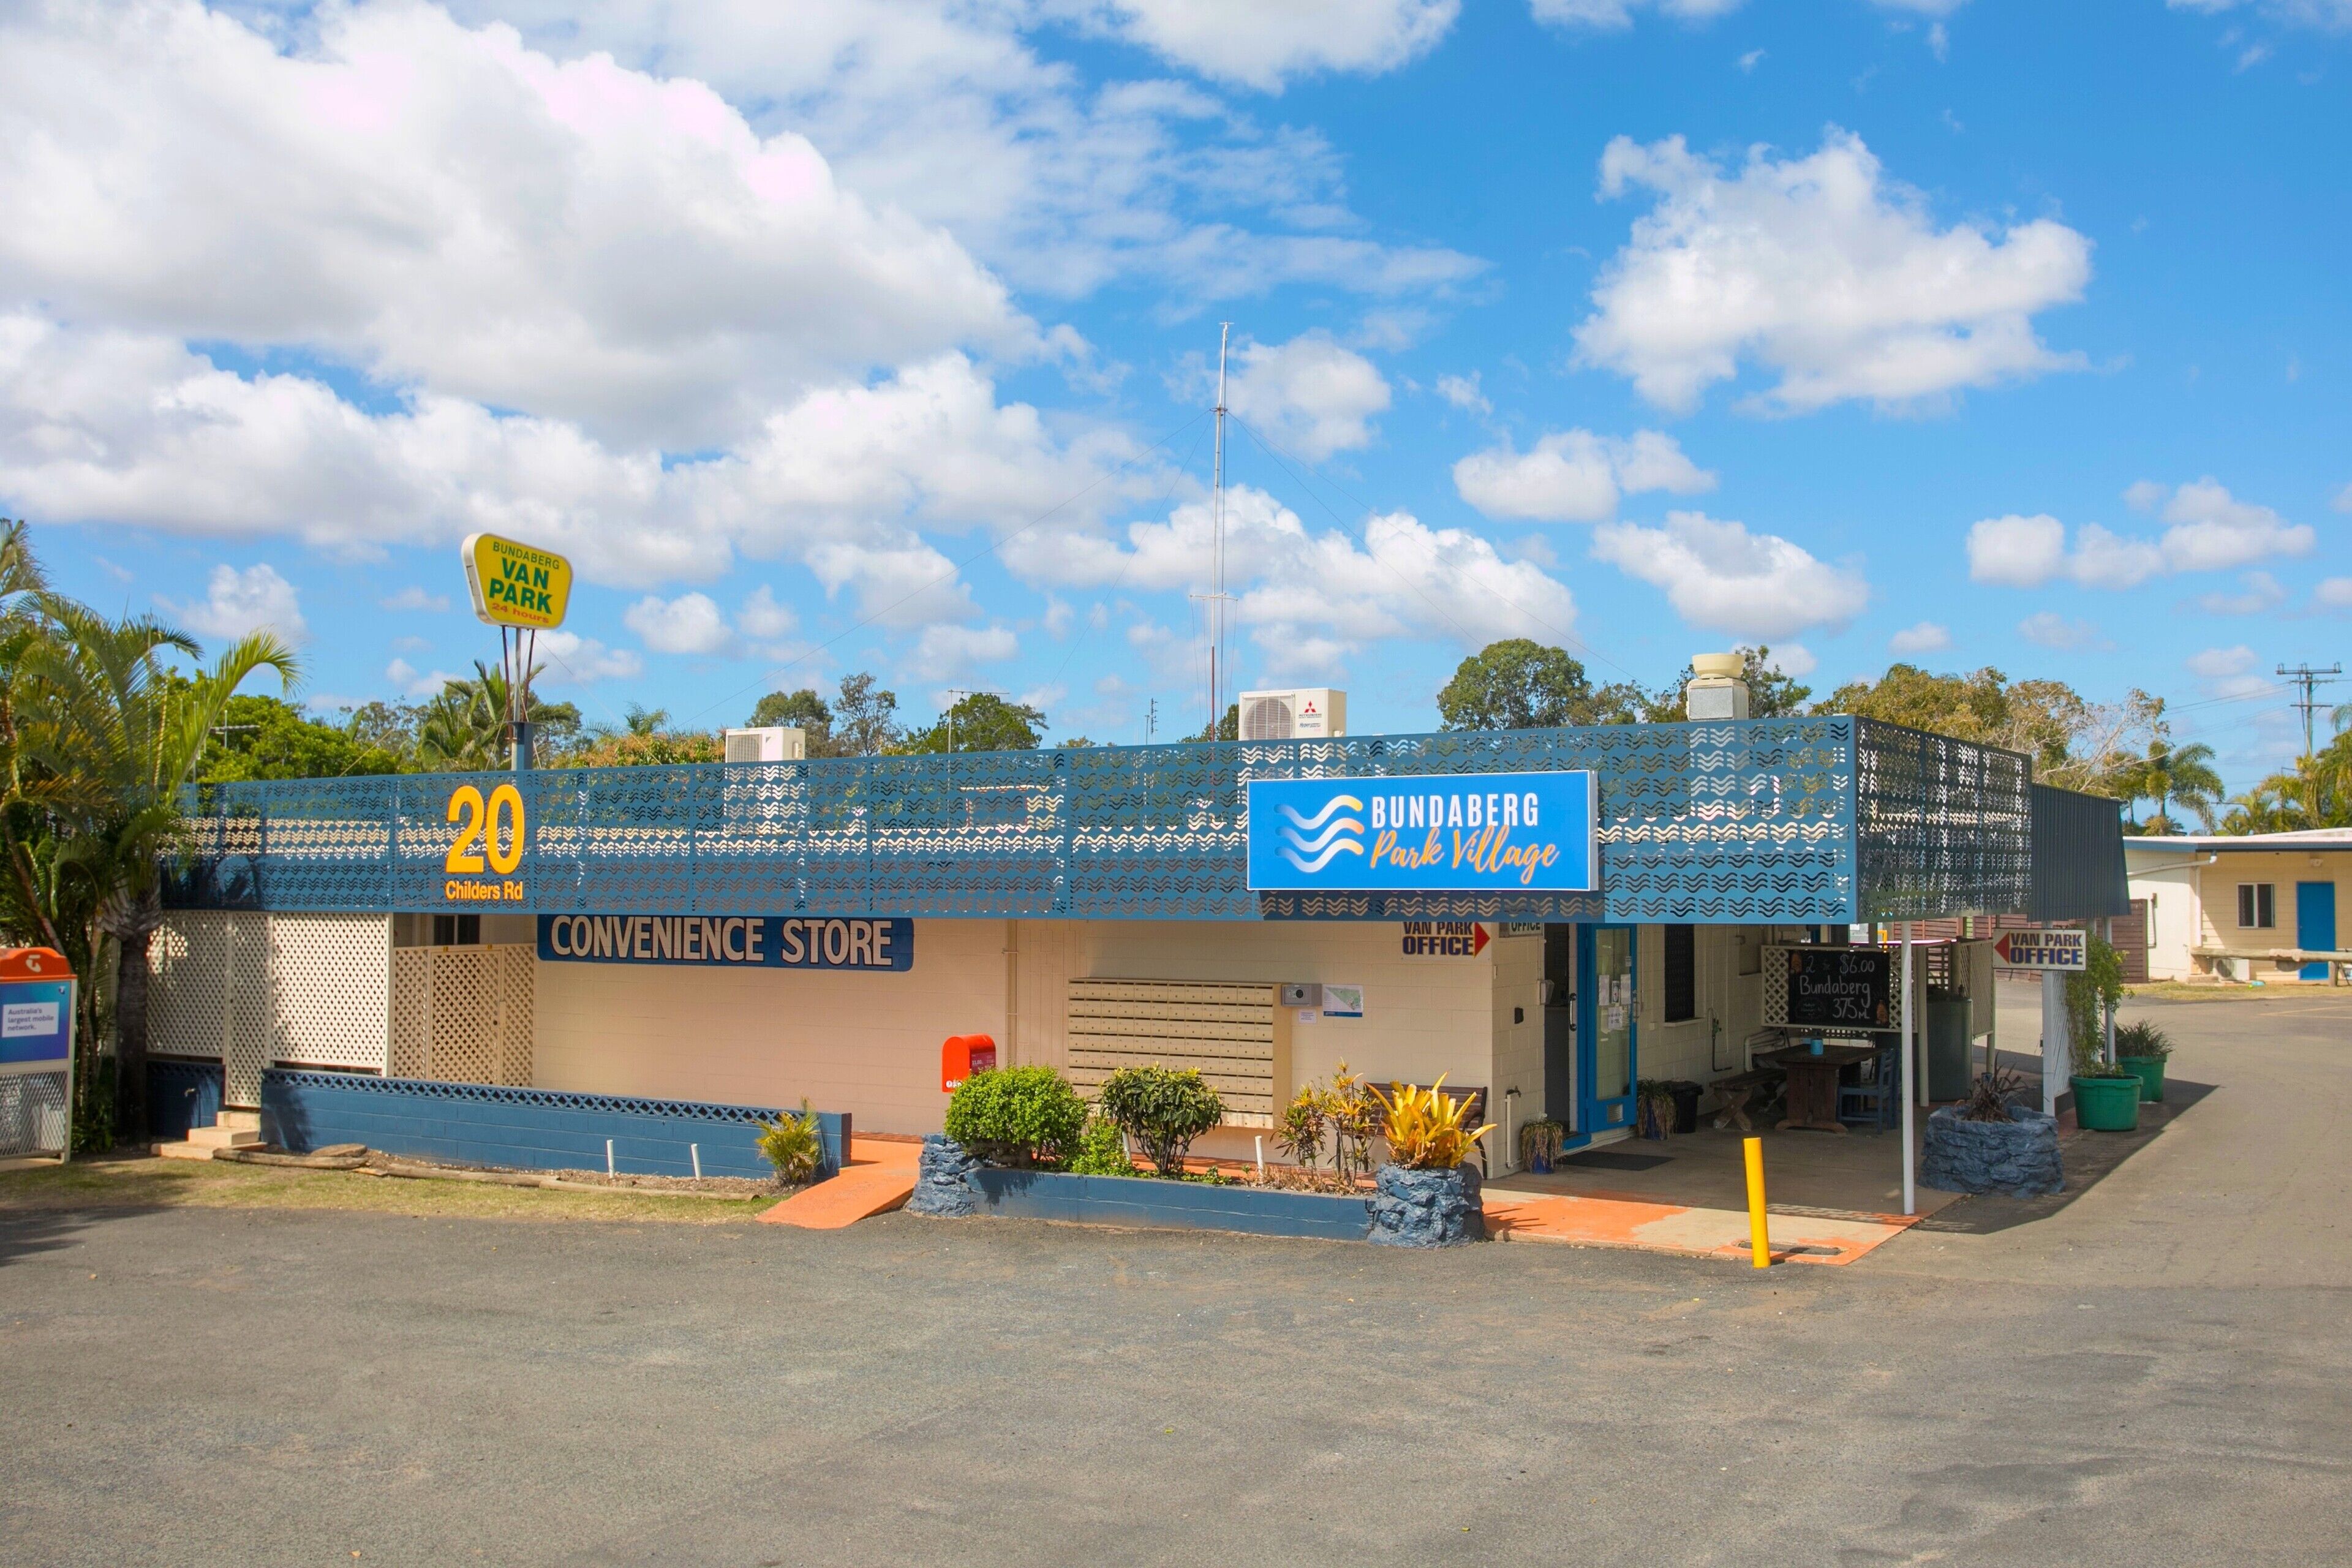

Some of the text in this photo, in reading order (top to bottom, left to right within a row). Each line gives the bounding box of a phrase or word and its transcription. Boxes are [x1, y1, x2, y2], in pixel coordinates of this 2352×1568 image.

[492, 541, 560, 570] BUNDABERG
[502, 557, 549, 590] VAN
[489, 578, 553, 615] PARK
[492, 603, 549, 624] 24 hours
[1372, 793, 1539, 828] BUNDABERG
[445, 783, 525, 875] 20
[1370, 824, 1561, 885] Park Village
[445, 880, 523, 901] Childers Rd
[1403, 921, 1473, 935] VAN PARK
[1511, 922, 1540, 932] OFFICE
[551, 915, 893, 966] CONVENIENCE STORE
[1403, 936, 1474, 956] OFFICE
[2010, 933, 2082, 947] VAN PARK
[1806, 956, 1815, 973] 2
[1839, 954, 1875, 975] $6.00
[2010, 948, 2082, 965] OFFICE
[1799, 974, 1871, 1009] Bundaberg
